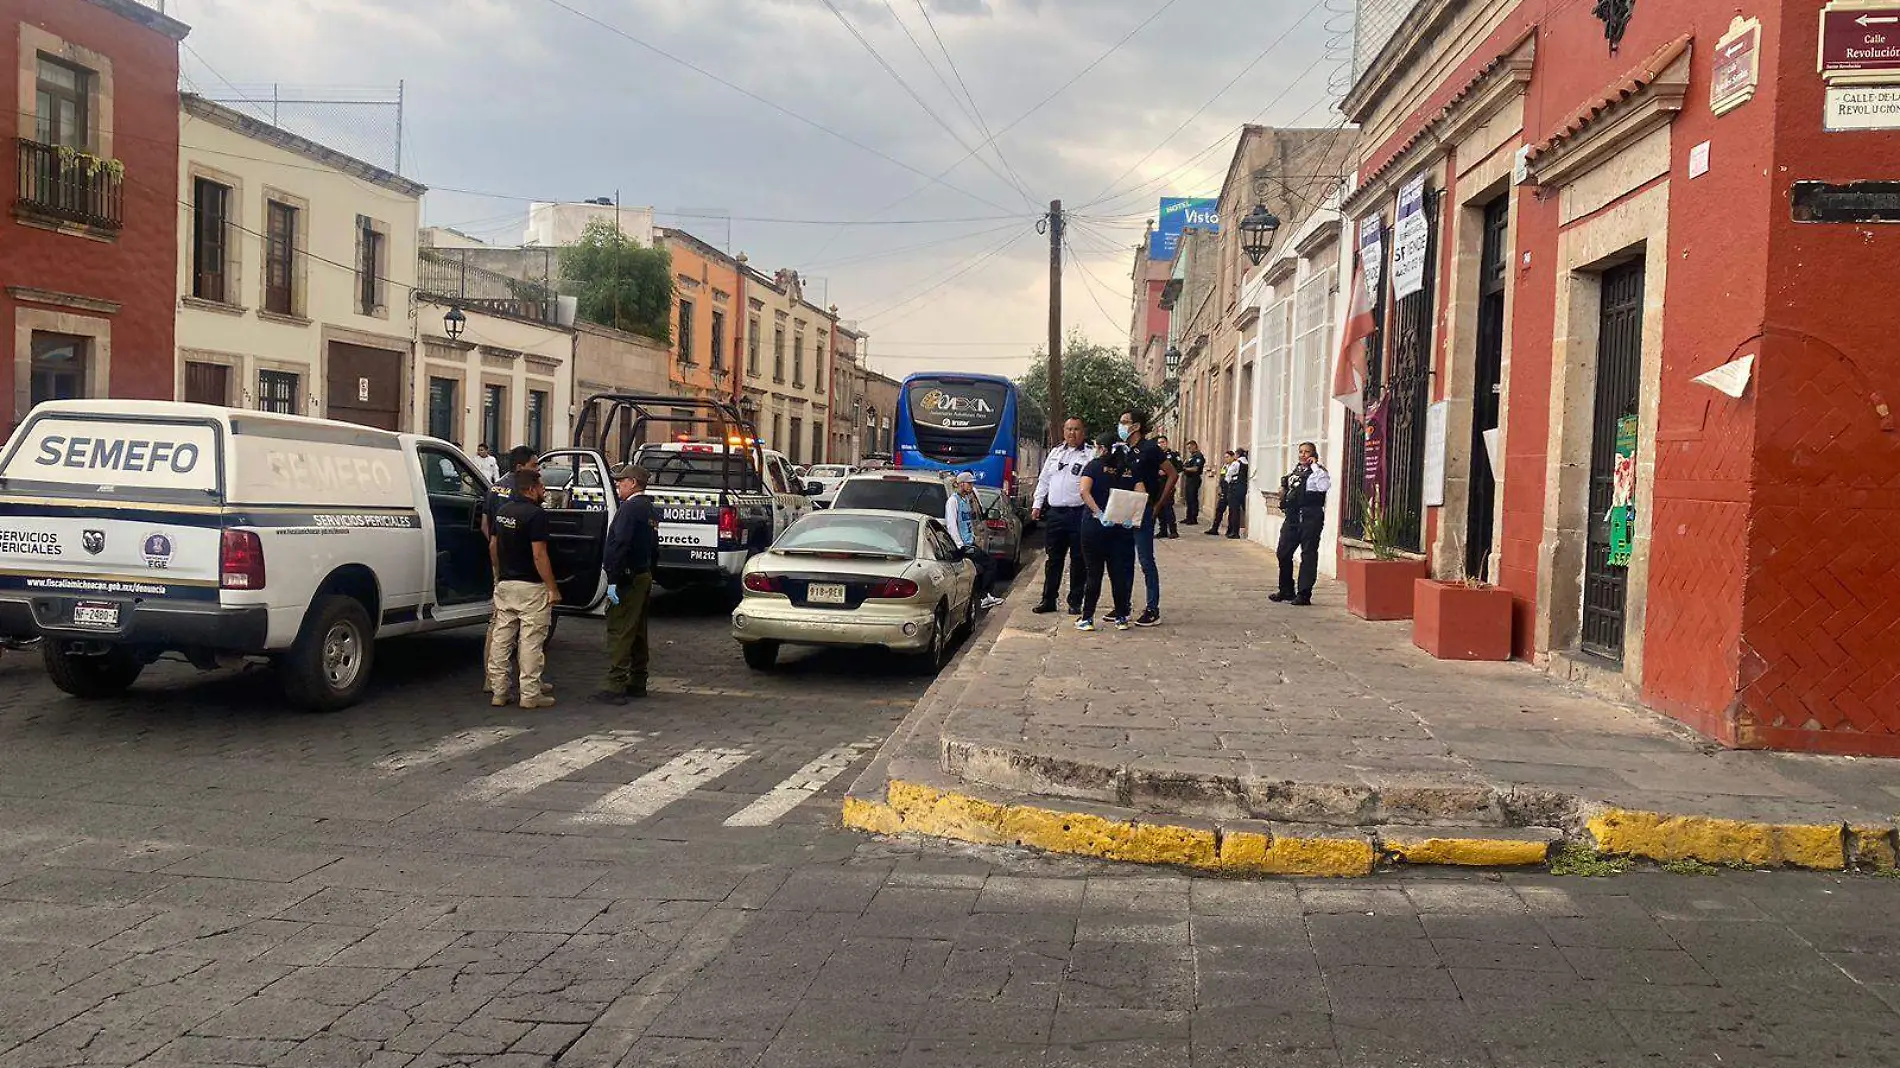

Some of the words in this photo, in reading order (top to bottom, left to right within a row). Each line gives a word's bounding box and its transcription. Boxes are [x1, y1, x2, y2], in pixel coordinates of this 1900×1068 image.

[1864, 34, 1886, 44] Calle
[35, 435, 199, 474] SEMEFO
[265, 450, 393, 493] SEMEFO
[313, 514, 365, 527] SERVICIOS
[364, 515, 412, 527] PERICIALES
[663, 508, 707, 521] MORELIA
[0, 542, 62, 555] ERICIALES
[690, 550, 716, 560] PM212
